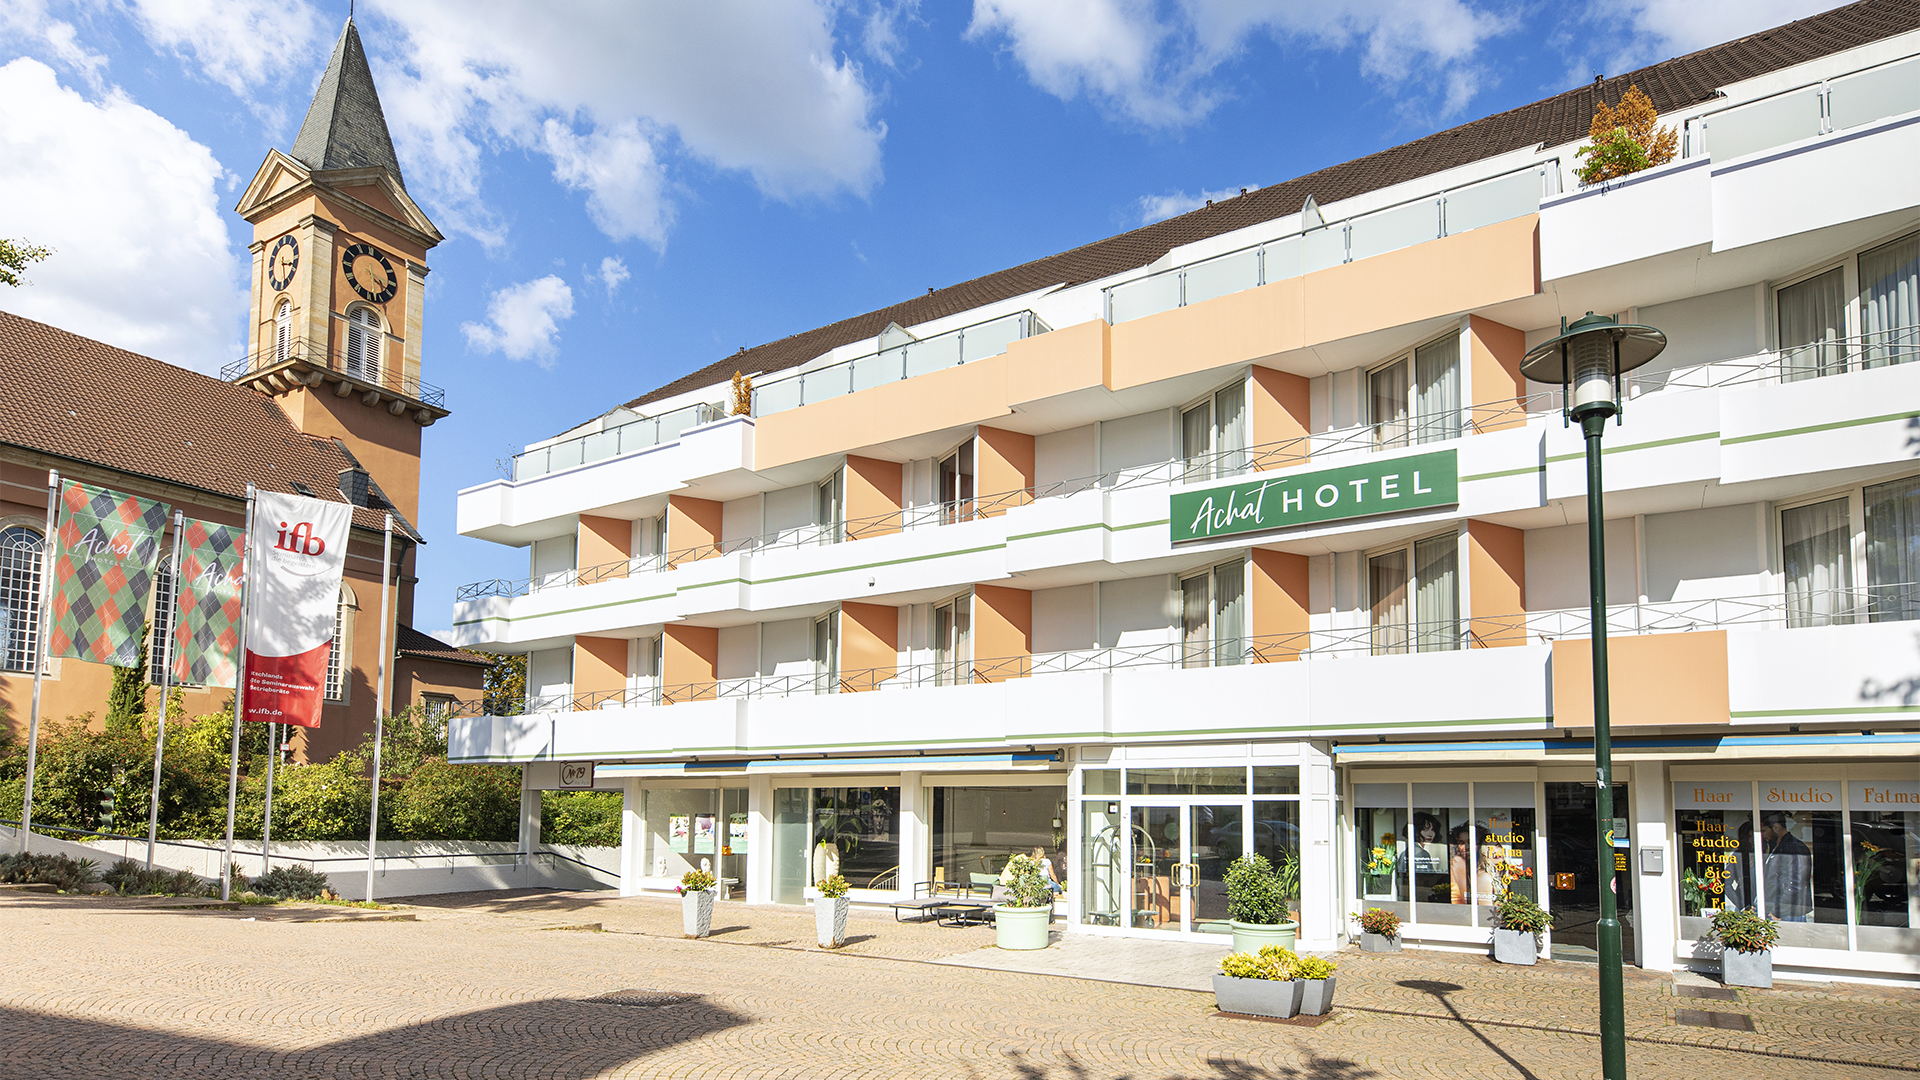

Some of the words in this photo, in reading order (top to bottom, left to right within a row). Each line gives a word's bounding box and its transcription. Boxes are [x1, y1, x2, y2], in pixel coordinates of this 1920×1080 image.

[1190, 479, 1288, 535] Achat
[1282, 470, 1433, 513] HOTEL
[74, 528, 159, 563] Achat
[274, 521, 326, 556] ifb
[90, 556, 125, 568] HOTELS
[195, 561, 243, 596] Acha
[1693, 788, 1734, 803] Haar
[1766, 787, 1833, 804] Studio
[1863, 787, 1920, 804] Fatma
[1488, 818, 1521, 829] Haar-
[1697, 820, 1735, 832] Haar-
[1485, 831, 1525, 843] studio
[1692, 835, 1741, 849] studio
[1488, 846, 1523, 857] Fatma
[1696, 850, 1738, 864] Fatma
[1711, 881, 1725, 895] &
[1711, 897, 1727, 910] Er
